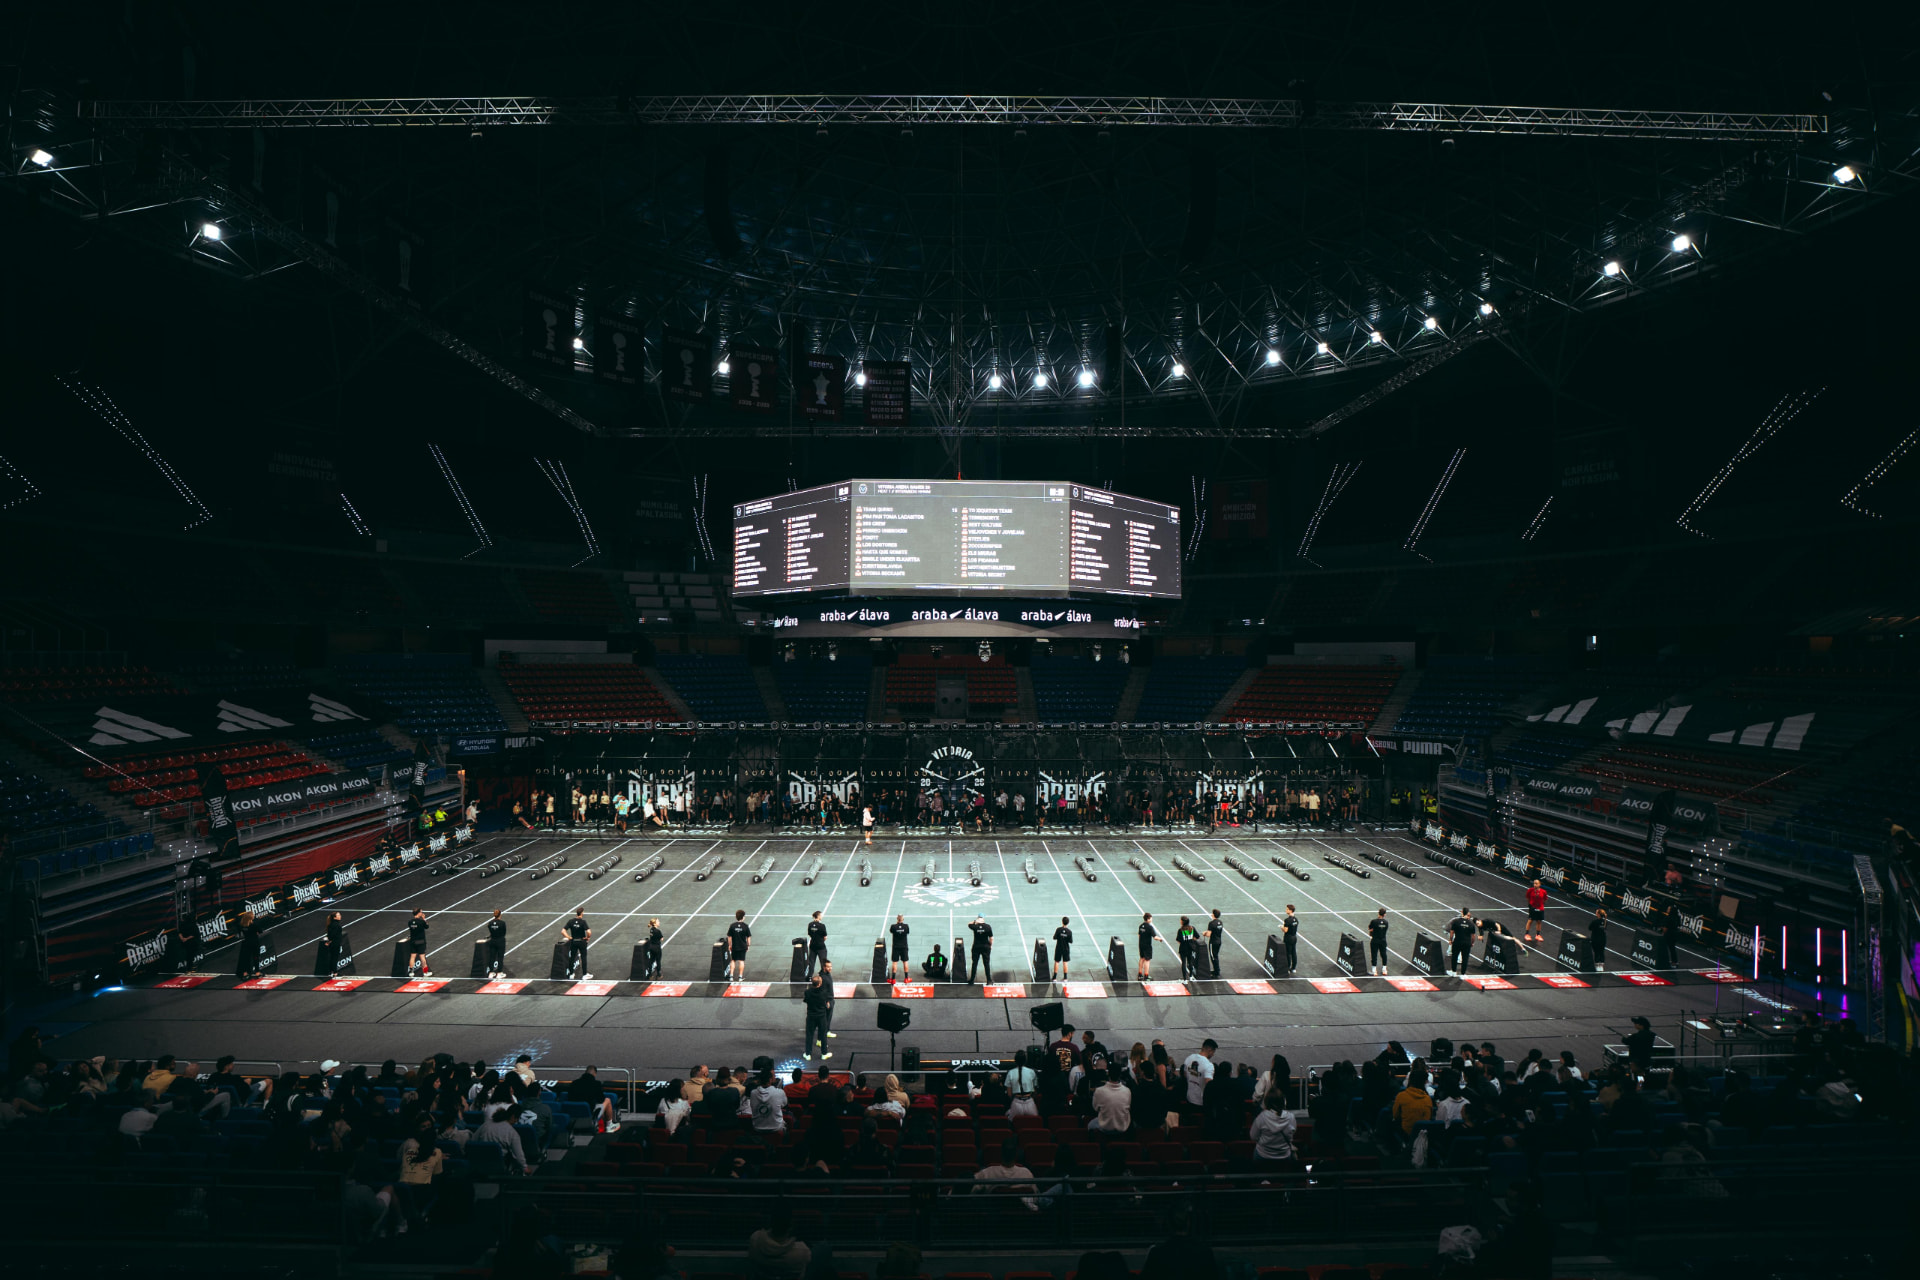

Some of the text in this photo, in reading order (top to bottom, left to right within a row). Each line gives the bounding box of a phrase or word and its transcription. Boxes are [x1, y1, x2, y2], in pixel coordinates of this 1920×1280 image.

[820, 608, 890, 622] araba álava
[911, 608, 998, 621] araba álava
[1021, 608, 1091, 623] araba álava
[931, 746, 973, 760] VITORIA
[1403, 740, 1442, 755] PUMA
[231, 776, 370, 813] KON AKON AKON AKON
[1527, 777, 1594, 797] AKON AKON
[1673, 805, 1707, 822] KON
[1505, 851, 1529, 872] ARENA
[334, 867, 359, 887] ARENA
[1541, 862, 1564, 884] ARENA
[294, 880, 321, 903] ARENA
[1579, 876, 1606, 899] ARENA
[1622, 890, 1651, 914] ARENA
[198, 914, 229, 940] RENA
[1418, 945, 1428, 955] 17
[1565, 942, 1577, 953] 19
[1637, 939, 1652, 951] 20
[1337, 957, 1354, 972] AKON
[1412, 957, 1432, 972] AKON
[1484, 955, 1505, 971] AKON
[1557, 953, 1581, 969] AKON
[1631, 951, 1657, 966] AKON
